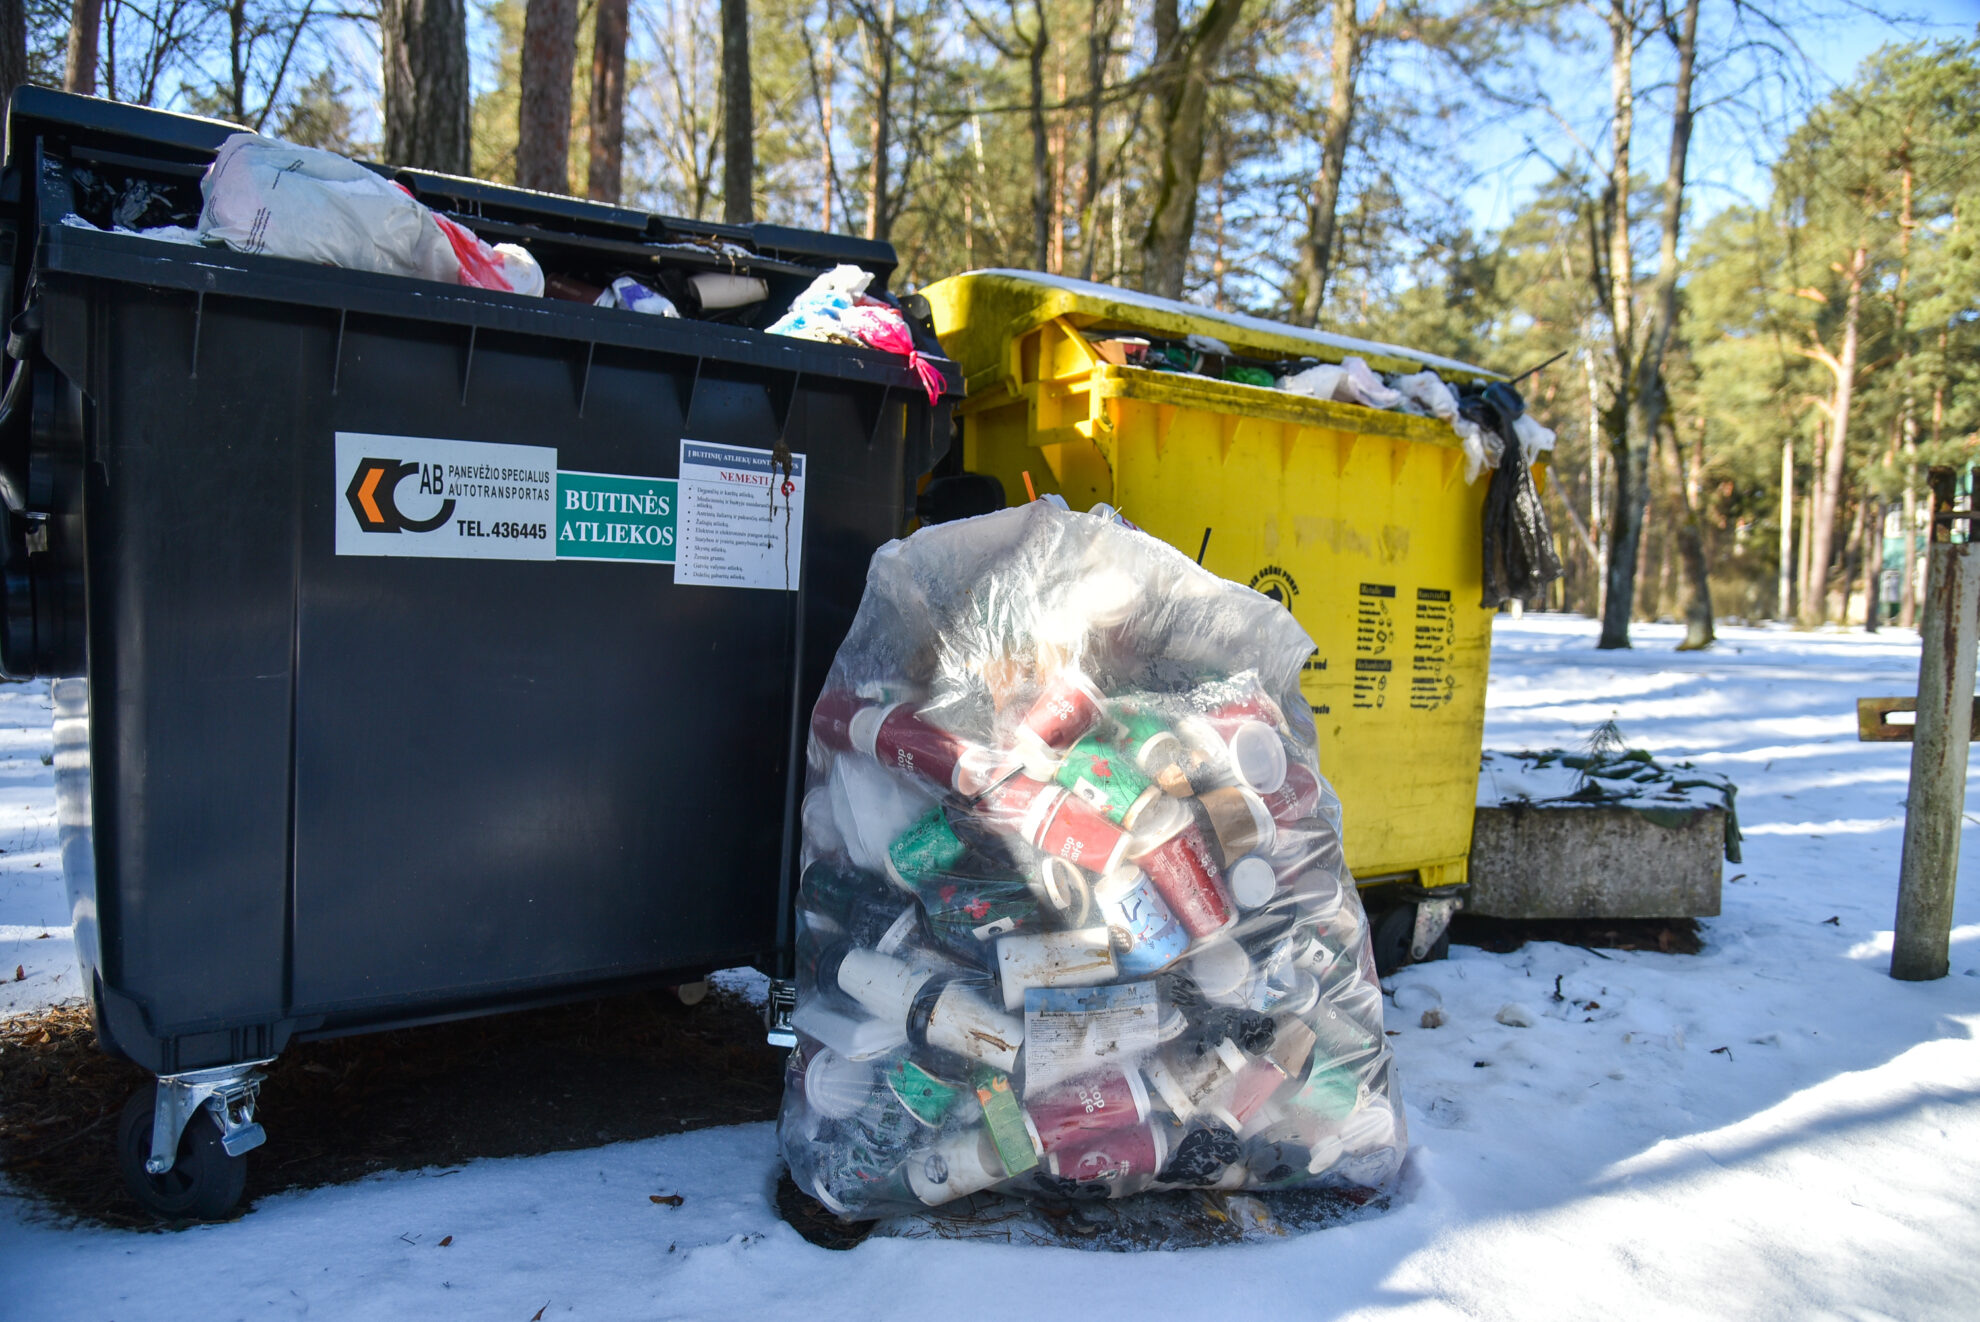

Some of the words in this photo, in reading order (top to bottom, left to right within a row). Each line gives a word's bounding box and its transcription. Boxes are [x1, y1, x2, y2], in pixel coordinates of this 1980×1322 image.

[420, 463, 444, 495] AB
[448, 464, 500, 480] PANEVĖŽIO
[501, 467, 550, 484] SPECIALUS
[719, 471, 769, 486] NEMESTI
[448, 483, 550, 501] AUTOTRANSPORTAS
[564, 489, 670, 516] BUITINĖS
[457, 519, 547, 540] TEL.436445
[559, 520, 674, 546] ATLIEKOS
